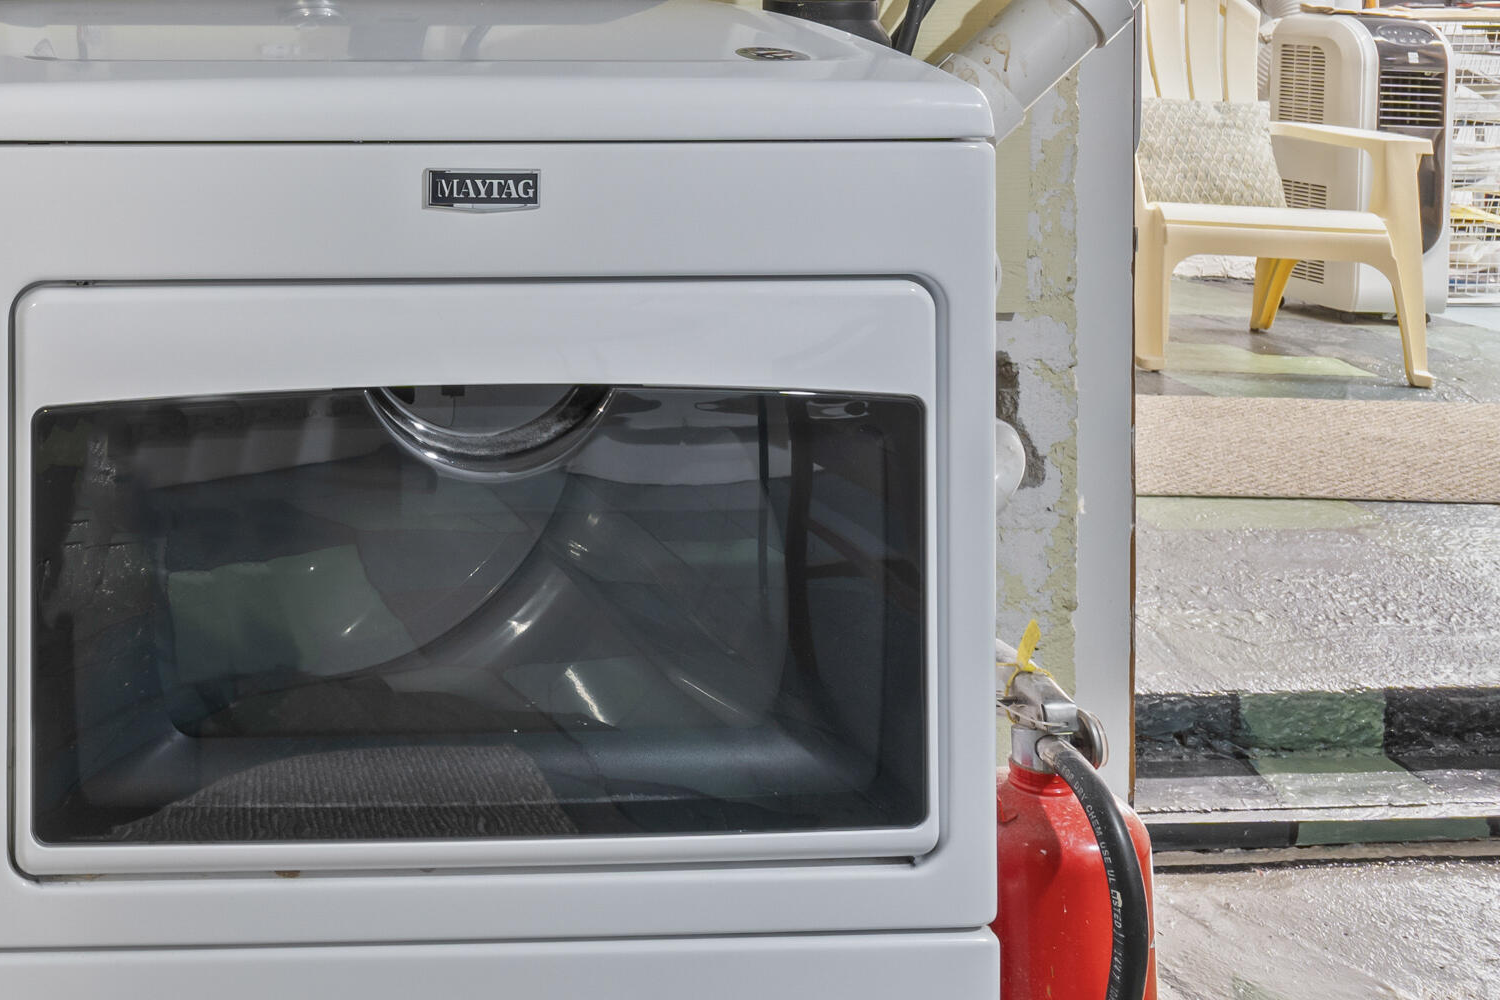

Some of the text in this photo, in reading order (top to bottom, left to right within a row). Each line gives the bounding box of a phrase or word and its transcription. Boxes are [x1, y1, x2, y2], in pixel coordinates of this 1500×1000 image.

[436, 178, 535, 198] MAYTAG
[1085, 804, 1103, 835] CHEM
[1100, 841, 1112, 864] USE
[1107, 869, 1116, 884] UL
